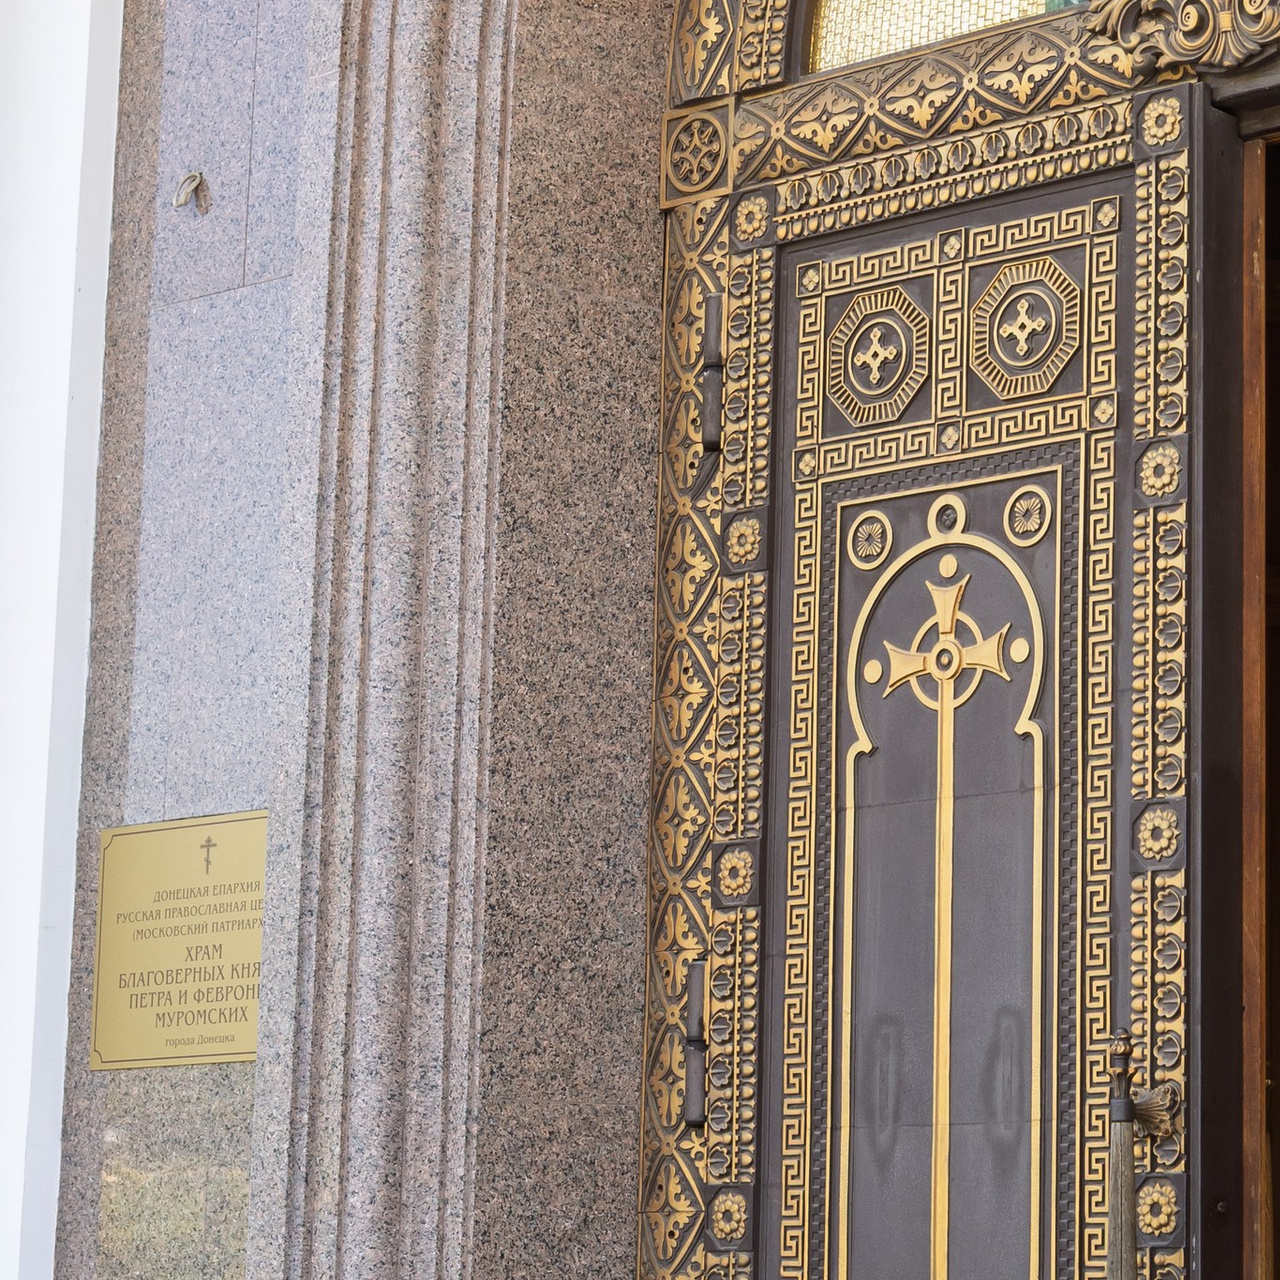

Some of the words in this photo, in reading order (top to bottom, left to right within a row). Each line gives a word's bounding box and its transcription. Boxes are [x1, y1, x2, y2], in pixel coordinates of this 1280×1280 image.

[153, 886, 209, 903] ДОНЕЦКАЯ
[212, 880, 261, 896] ЕПАРХИЯ
[116, 909, 161, 924] РУССКАЯ
[164, 900, 247, 920] ПРАВОСЛАВНАЯ
[132, 921, 208, 942] (МОСКОВСКИЙ
[185, 944, 223, 962] ХРАМ
[118, 964, 225, 989] БЛАГОВЕРНЫХ
[129, 991, 173, 1009] ПЕТРА
[178, 989, 188, 1005] И
[155, 1006, 249, 1028] МУРОМСКИХ
[165, 1037, 195, 1048] города
[197, 1034, 235, 1045] Донецка
